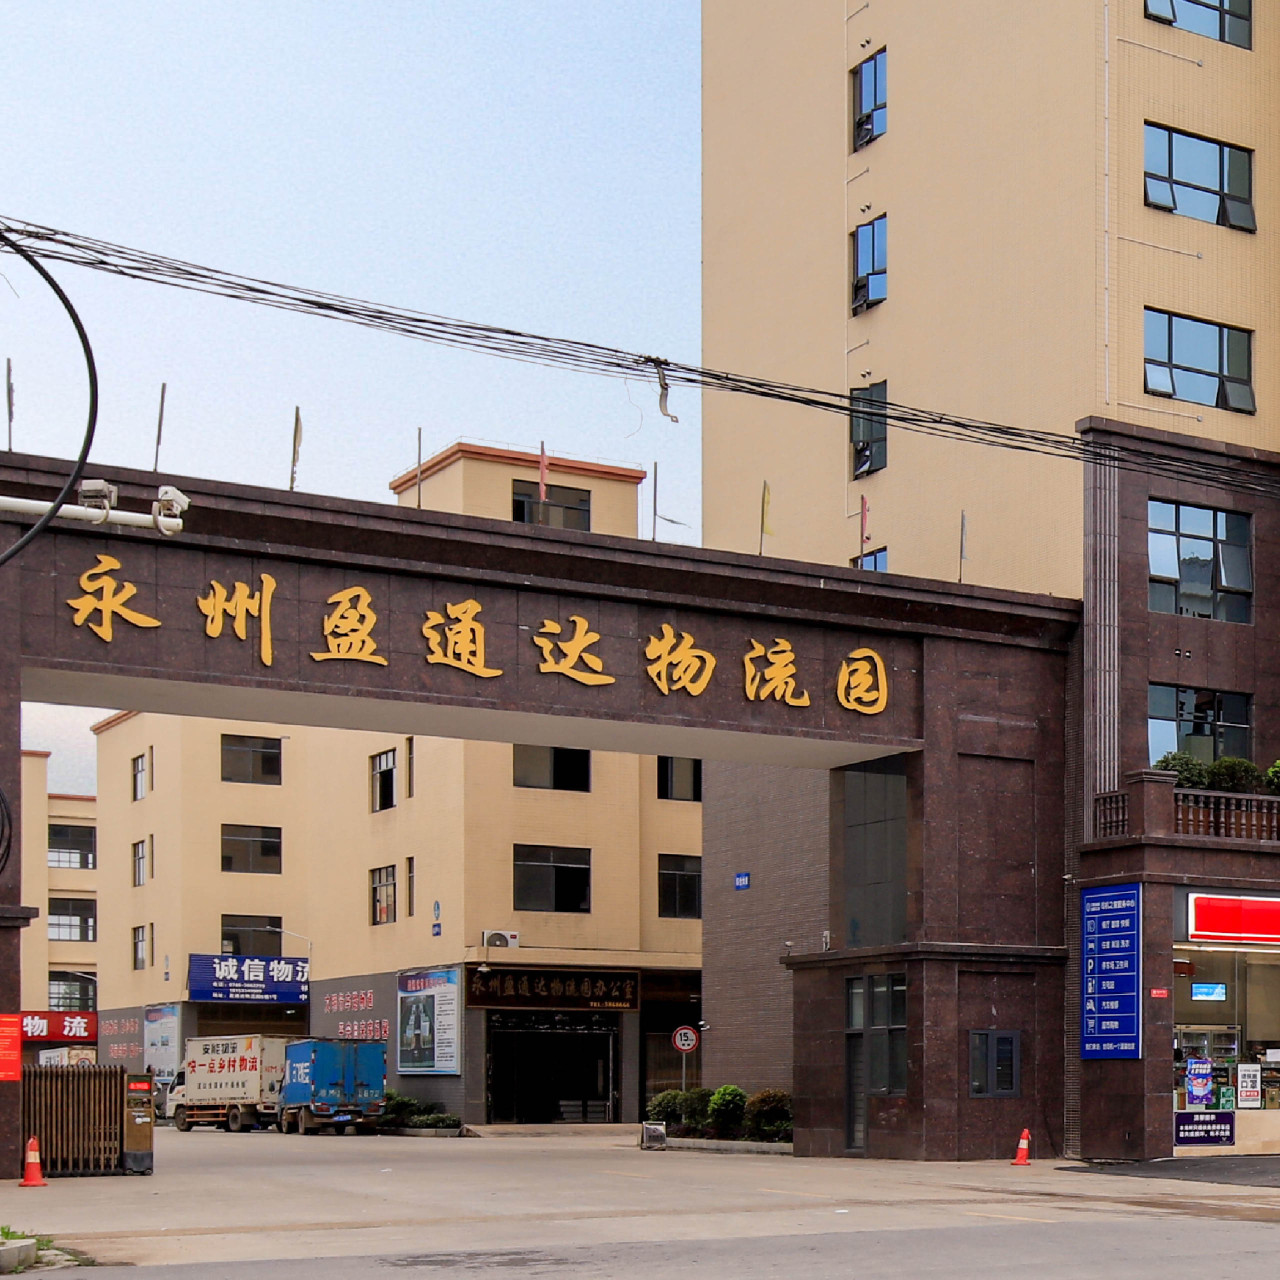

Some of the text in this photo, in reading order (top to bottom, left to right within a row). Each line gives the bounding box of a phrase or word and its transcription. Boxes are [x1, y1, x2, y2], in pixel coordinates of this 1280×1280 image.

[66, 554, 889, 716] 永州盈通达物流园
[22, 1015, 89, 1037] 物流
[679, 1032, 689, 1042] 15
